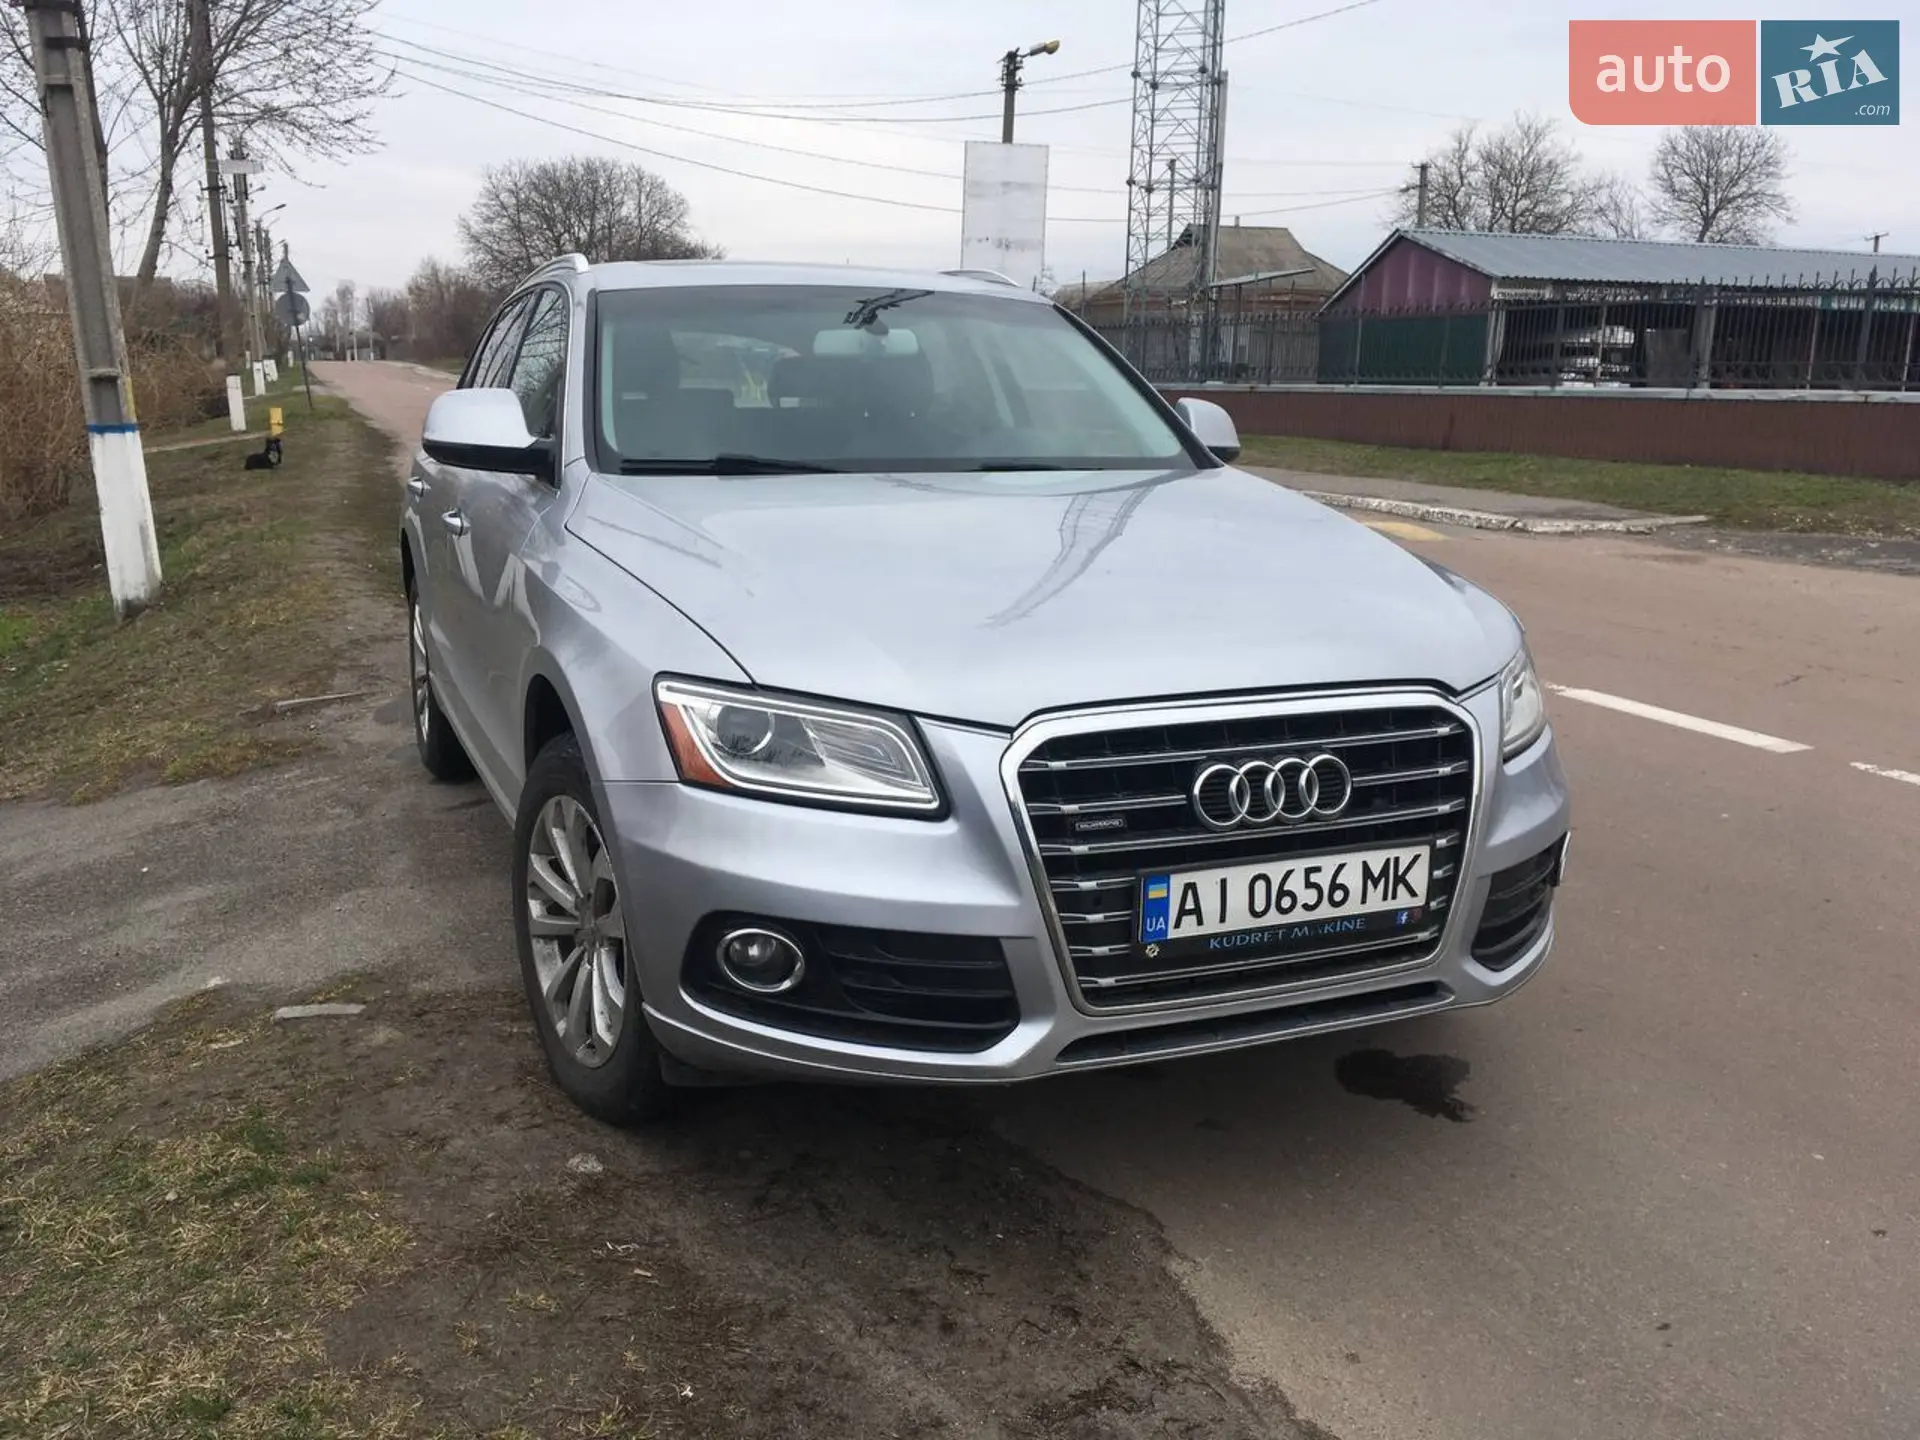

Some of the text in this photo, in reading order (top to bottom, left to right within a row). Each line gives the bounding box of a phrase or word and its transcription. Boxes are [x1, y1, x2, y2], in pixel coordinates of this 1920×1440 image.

[1173, 853, 1422, 930] AI 0656 MK
[1146, 916, 1166, 932] UA
[1209, 929, 1286, 949] KUDRET
